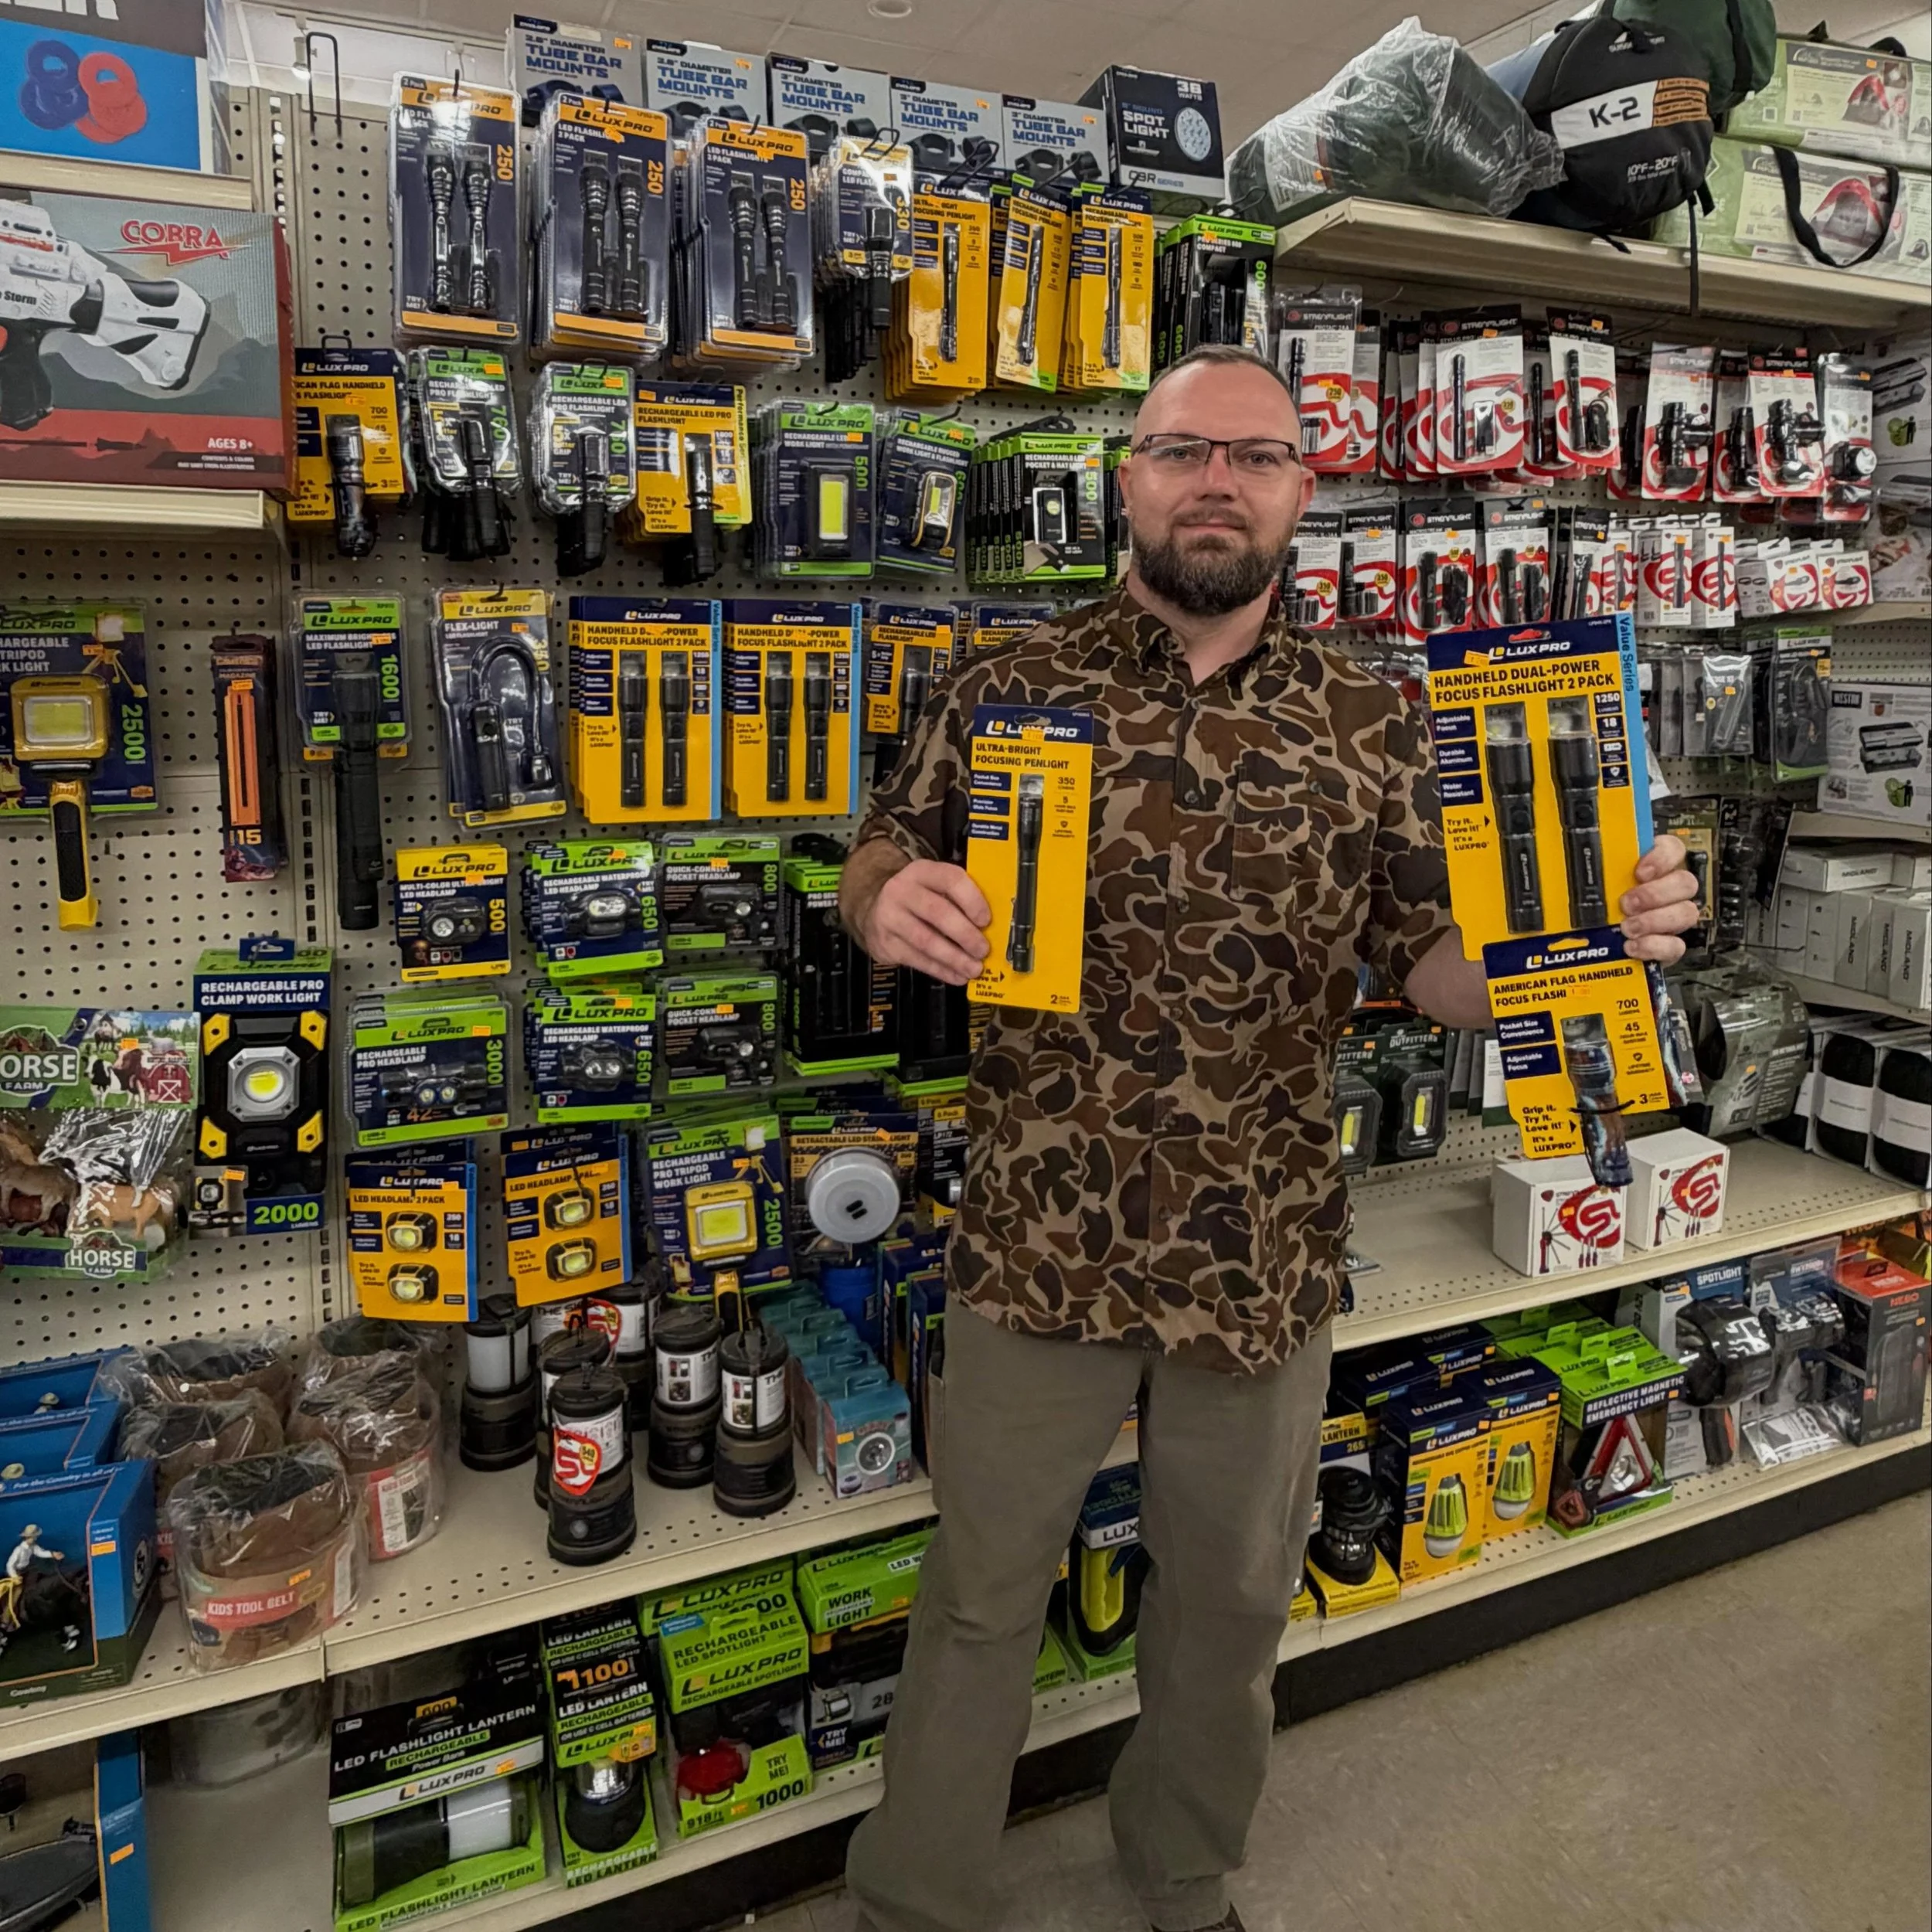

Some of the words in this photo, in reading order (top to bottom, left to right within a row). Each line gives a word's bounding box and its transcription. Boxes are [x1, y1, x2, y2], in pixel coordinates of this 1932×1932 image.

[526, 43, 579, 62] TUBE
[583, 53, 621, 69] BAR
[526, 56, 608, 79] MOUNTS
[658, 66, 708, 83] TUBE
[712, 74, 747, 90] BAR
[794, 75, 842, 89] DIAMETER
[658, 78, 734, 99] MOUNTS
[781, 81, 827, 98] TUBE
[832, 90, 865, 104] BAR
[782, 94, 853, 114] MOUNTS
[913, 95, 957, 107] DIAMETER
[900, 101, 943, 117] TUBE
[947, 108, 978, 122] BAR
[1023, 112, 1066, 124] DIAMETER
[1123, 111, 1165, 126] SPOT
[1589, 97, 1641, 128] K-2
[558, 124, 570, 132] LED
[901, 113, 968, 132] MOUNTS
[1012, 118, 1053, 133] TUBE
[1056, 125, 1085, 138] BAR
[1124, 122, 1169, 138] LIGHT
[565, 133, 585, 142] PACK
[1013, 129, 1076, 146] MOUNTS
[497, 145, 513, 181] 250
[648, 161, 664, 195] 250
[790, 178, 805, 210] 250
[121, 220, 229, 259] COBRA
[1198, 244, 1226, 253] COMPACT
[4, 291, 37, 306] Storm
[552, 396, 610, 406] RECHARGEABLE
[638, 407, 699, 417] RECHARGEABLE
[736, 389, 744, 442] Performance
[208, 438, 236, 448] AGES
[784, 433, 835, 441] RECHARGEABLE
[855, 455, 868, 488] 500
[1085, 472, 1098, 501] 500
[444, 621, 498, 631] FLEX-LIGHT
[852, 605, 860, 631] Value
[306, 634, 346, 642] MAXIMUM
[588, 627, 638, 635] HANDHELD
[738, 628, 784, 637] HANDHELD
[1620, 618, 1631, 651] Value
[323, 641, 373, 649] FLASHLIGHT
[588, 636, 618, 645] FOCUS
[1, 651, 46, 659] TRIPOD
[13, 662, 50, 672] LIGHT
[1434, 671, 1507, 688] HANDHELD
[1511, 660, 1600, 680] DUAL-POWER
[1624, 653, 1634, 692] Series
[381, 654, 399, 700] 1600
[1436, 688, 1480, 702] FOCUS
[1483, 679, 1564, 698] FLASHLIGHT
[1568, 679, 1575, 689] 2
[1578, 673, 1614, 687] PACK
[1596, 694, 1620, 702] 1250
[1436, 715, 1470, 724] Adjustable
[1604, 718, 1617, 727] 18
[121, 704, 145, 760] 2500
[976, 743, 1042, 754] ULTRA-BRIGHT
[975, 755, 1021, 766] FOCUSING
[1025, 759, 1069, 769] PENLIGHT
[236, 829, 261, 845] 15
[544, 877, 597, 887] RECHARGEABLE
[763, 864, 777, 892] 800
[415, 889, 456, 898] HEADLAMP
[489, 899, 505, 931] 500
[640, 896, 658, 930] 650
[1903, 930, 1912, 980] MIDLAND
[202, 981, 297, 993] RECHARGEABLE
[299, 980, 324, 990] PRO
[1494, 980, 1547, 994] AMERICAN
[1550, 975, 1576, 985] FLAG
[1579, 966, 1633, 981] HANDHELD
[202, 995, 243, 1005] CLAMP
[247, 995, 284, 1004] WORK
[287, 992, 321, 1002] LIGHT
[1051, 995, 1057, 1004] 2
[1496, 995, 1529, 1006] FOCUS
[1617, 998, 1638, 1009] 700
[543, 1027, 599, 1036] RECHARGEABLE
[601, 1025, 648, 1034] WATERPROOF
[1499, 1021, 1523, 1029] Pocket
[1625, 1022, 1640, 1032] 45
[1501, 1029, 1544, 1039] Convenience
[357, 1046, 427, 1060] RECHARGEABLE
[1507, 1053, 1543, 1063] Adjustable
[357, 1060, 376, 1069] PRO
[378, 1055, 426, 1066] HEADLAMP
[486, 1040, 503, 1084] 3000
[1640, 1094, 1647, 1104] 3
[653, 1151, 726, 1169] RECHARGEABLE
[654, 1169, 673, 1179] PRO
[676, 1165, 709, 1177] TRIPOD
[655, 1179, 682, 1189] WORK
[685, 1173, 712, 1184] LIGHT
[254, 1202, 318, 1224] 2000
[71, 1250, 134, 1270] HORSE
[1696, 1267, 1742, 1285] SPOTLIGHT
[1587, 1391, 1638, 1412] REFLECTIVE
[1641, 1376, 1685, 1395] MAGNETIC
[1587, 1402, 1638, 1422] EMERGENCY
[1641, 1393, 1665, 1407] LIGHT
[1323, 1427, 1359, 1442] LANTERN
[208, 1602, 232, 1615] KIDS
[236, 1597, 264, 1612] TOOL
[267, 1592, 294, 1607] BELT
[829, 1588, 871, 1607] WORK
[828, 1607, 871, 1628] LIGHT
[674, 1616, 797, 1659] RECHARGEABLE
[676, 1655, 698, 1668] LED
[701, 1635, 766, 1662] SPOTLIGHT
[681, 1677, 752, 1705] RECHARGEABLE
[754, 1662, 801, 1683] SPOTLIGHT
[560, 1702, 585, 1717] LED
[335, 1755, 365, 1771] LED
[370, 1726, 463, 1762] FLASHLIGHT
[468, 1705, 536, 1732] LANTERN
[389, 1733, 486, 1767] RECHARGEABLE
[766, 1753, 786, 1767] TRY
[769, 1765, 789, 1779] ME!
[757, 1780, 804, 1809] 1000
[686, 1813, 711, 1828] 918
